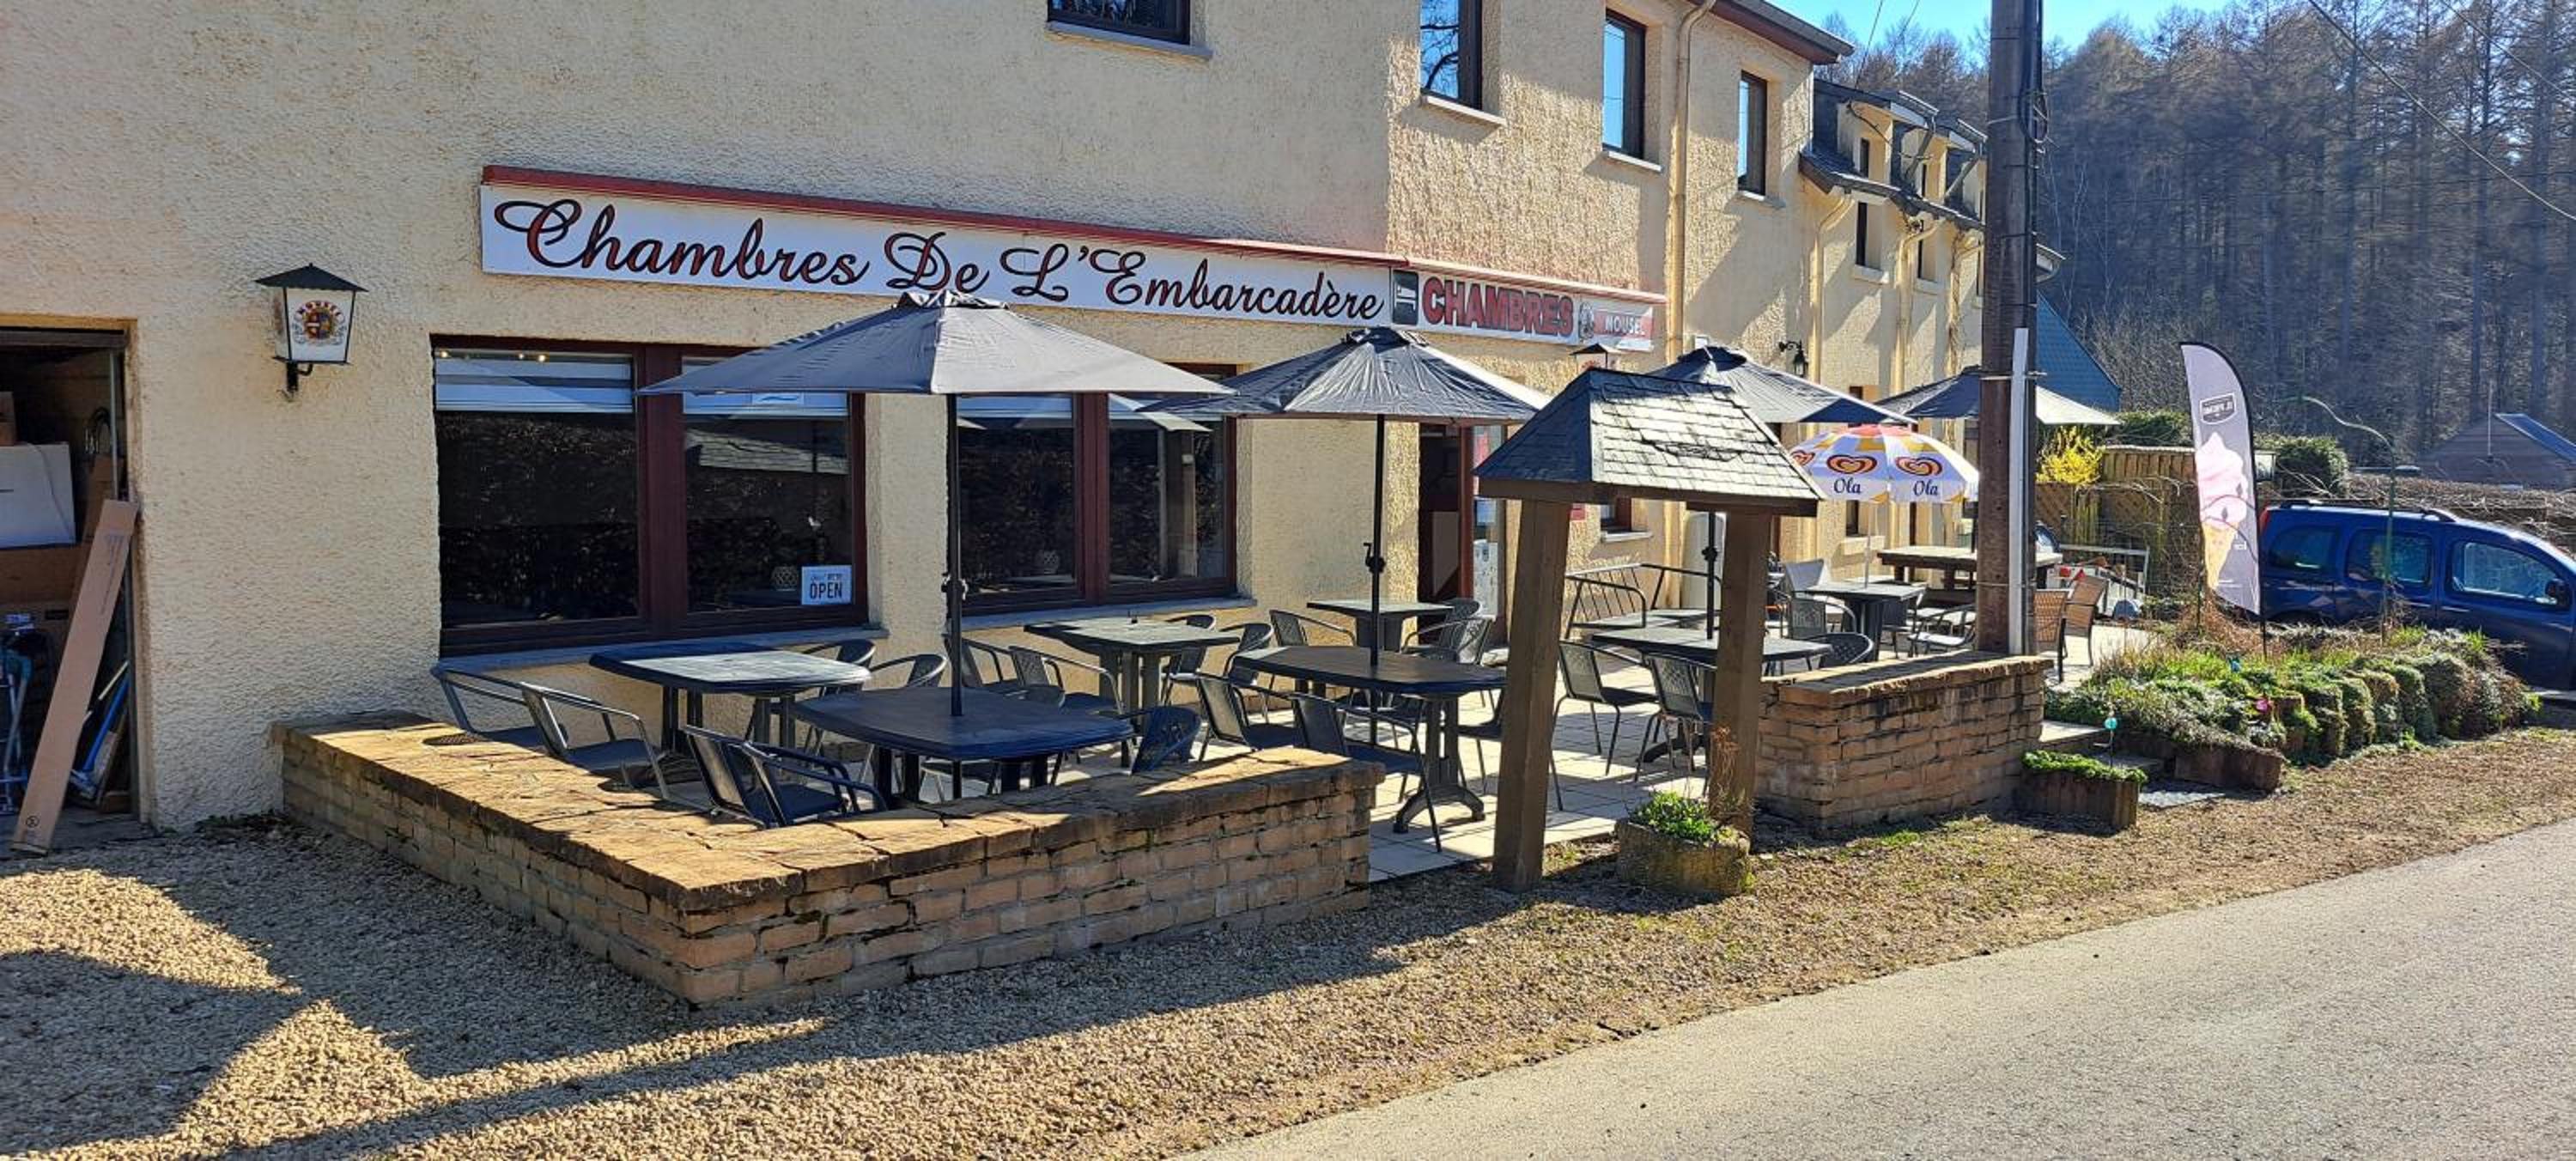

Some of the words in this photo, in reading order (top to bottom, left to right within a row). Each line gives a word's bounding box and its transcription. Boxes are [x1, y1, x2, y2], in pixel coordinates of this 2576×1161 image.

[494, 198, 870, 285] Chambres
[884, 231, 990, 294] De
[999, 243, 1385, 320] L'Embarcadère
[1422, 276, 1574, 338] CHAMBRES
[1833, 477, 1862, 495] Ola
[1913, 480, 1939, 497] Ola
[810, 582, 842, 599] OPEN
